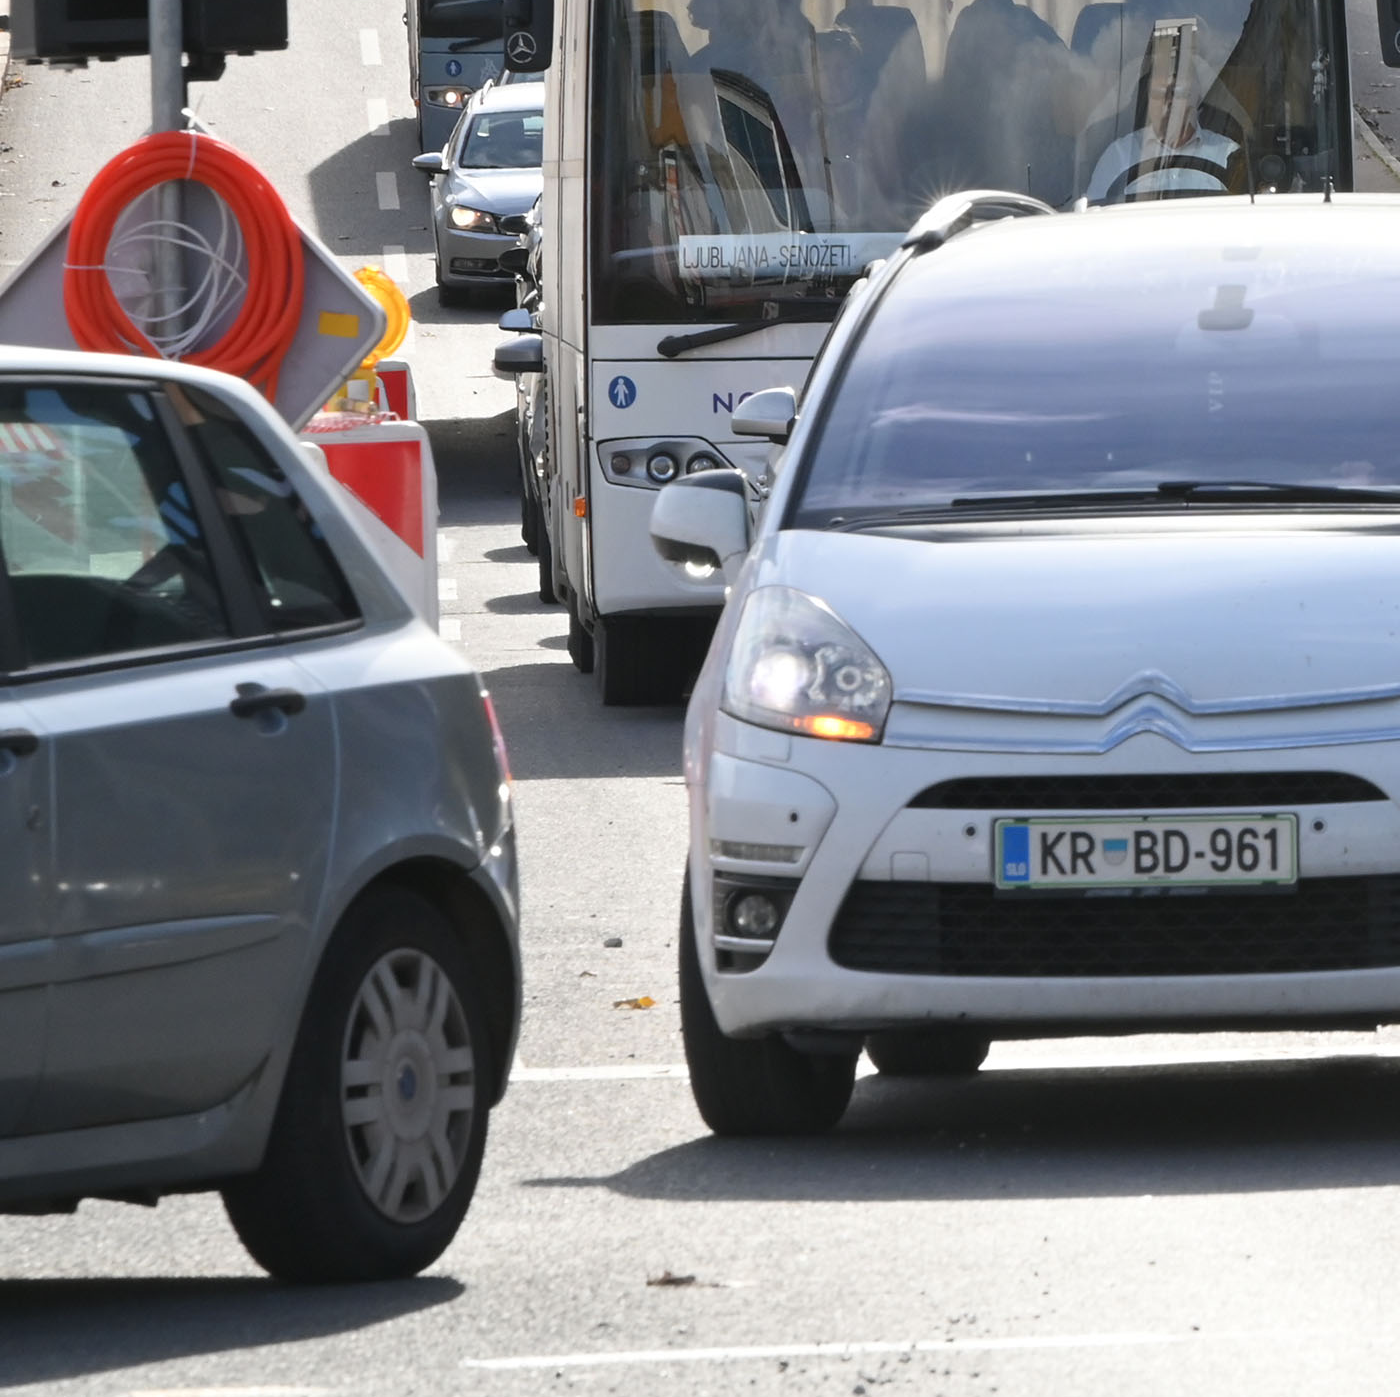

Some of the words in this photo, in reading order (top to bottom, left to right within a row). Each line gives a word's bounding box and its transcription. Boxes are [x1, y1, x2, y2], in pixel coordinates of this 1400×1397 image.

[683, 244, 769, 269] LJUBLJANA
[779, 239, 851, 268] SENOŽETI
[1005, 862, 1027, 877] SLO
[1040, 831, 1096, 876] KR
[1133, 827, 1278, 875] BD-961
